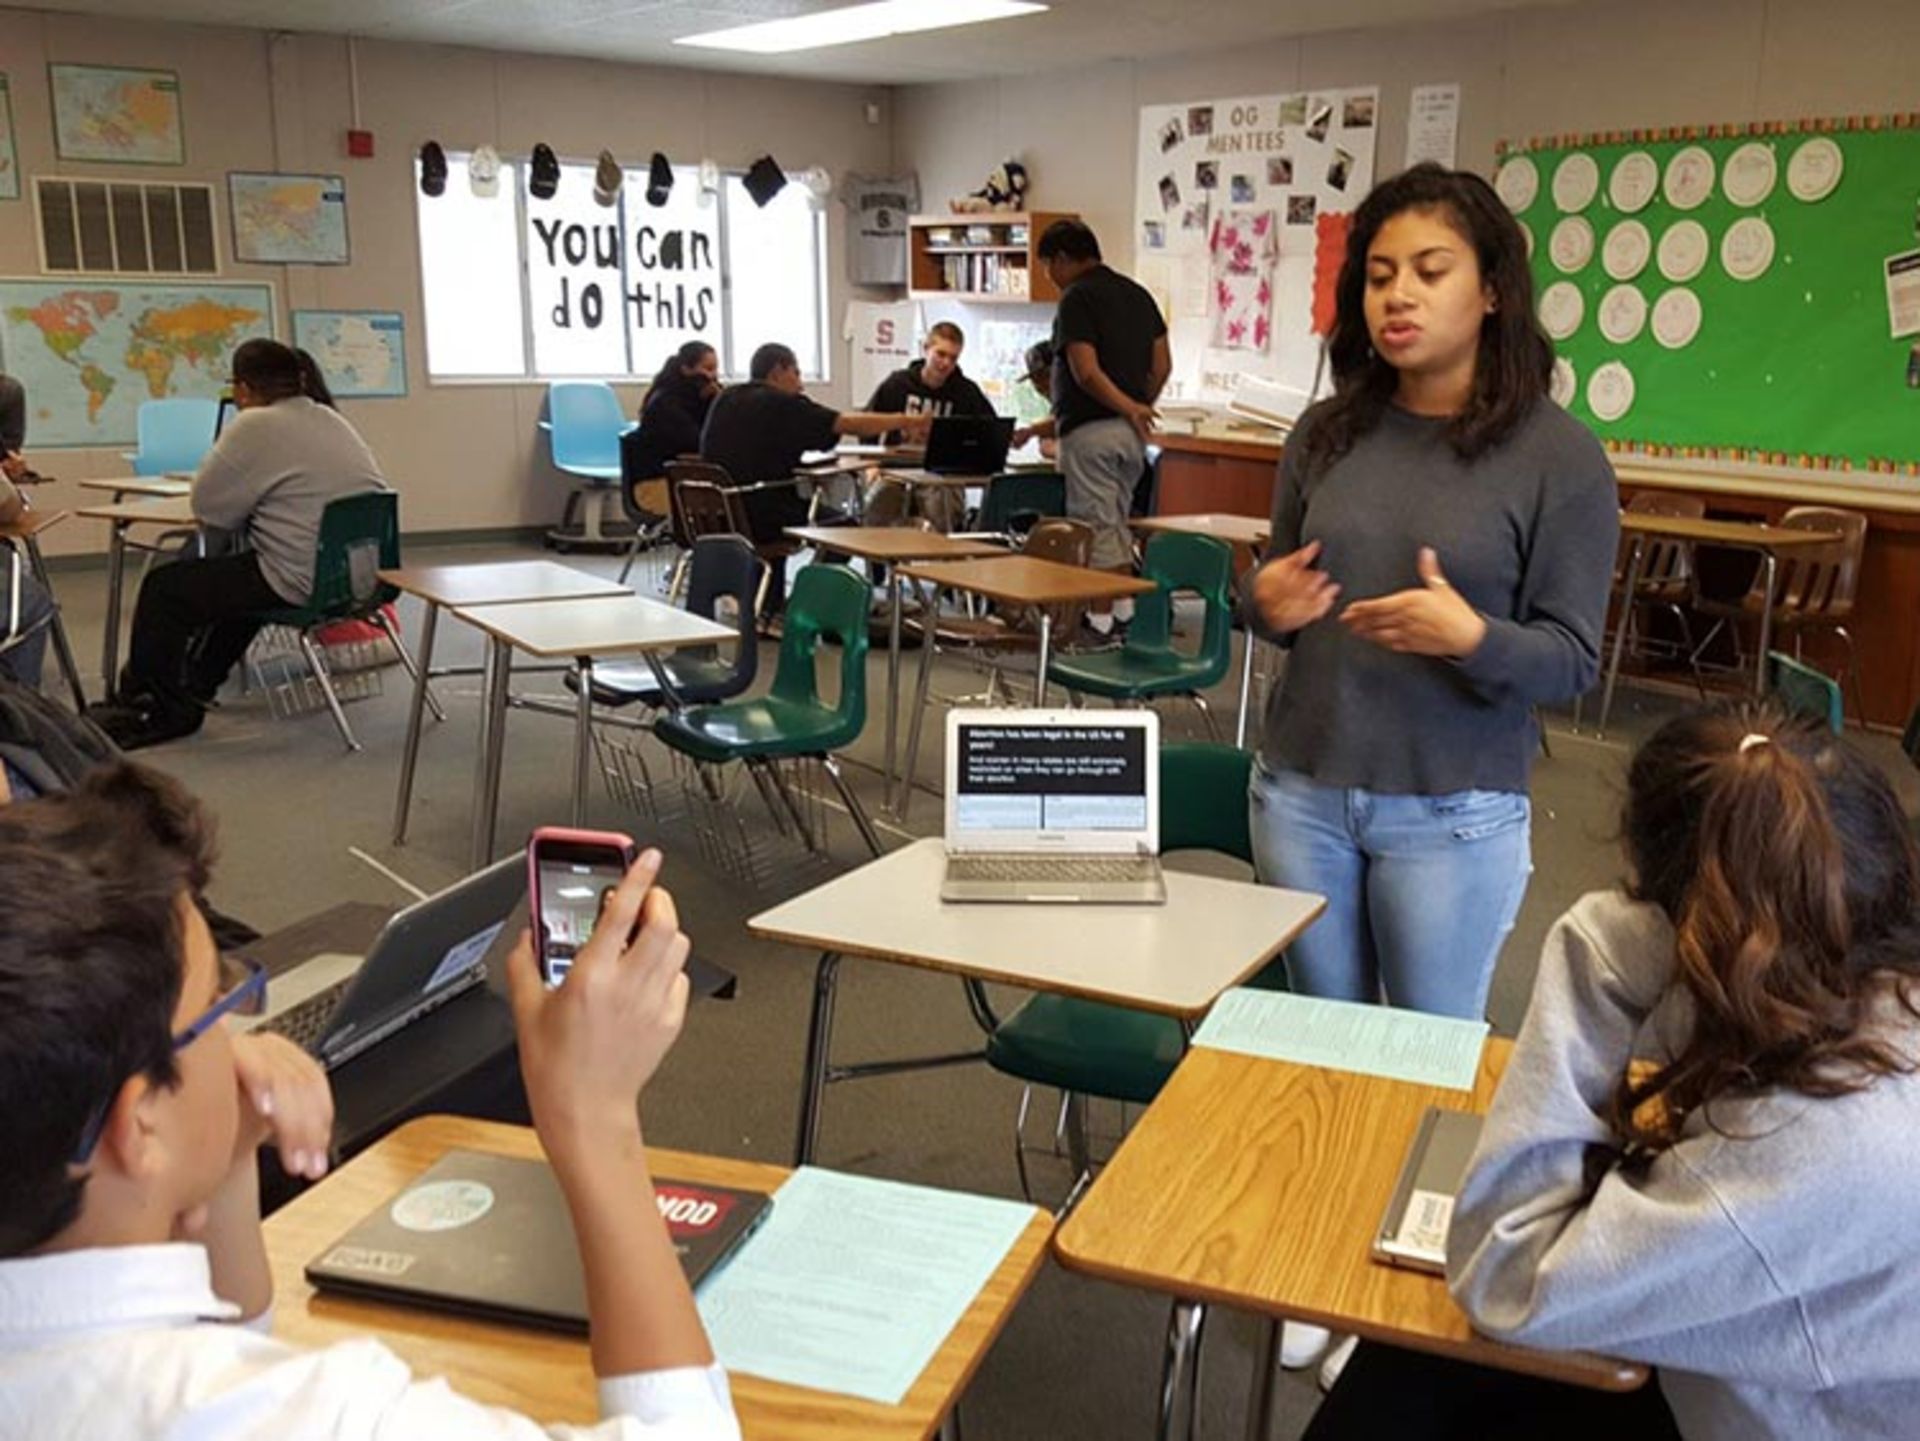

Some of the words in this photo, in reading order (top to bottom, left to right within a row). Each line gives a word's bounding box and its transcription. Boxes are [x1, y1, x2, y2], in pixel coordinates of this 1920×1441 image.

[1230, 106, 1259, 126] OG
[636, 226, 713, 270] can
[552, 276, 602, 329] do
[877, 319, 894, 346] S
